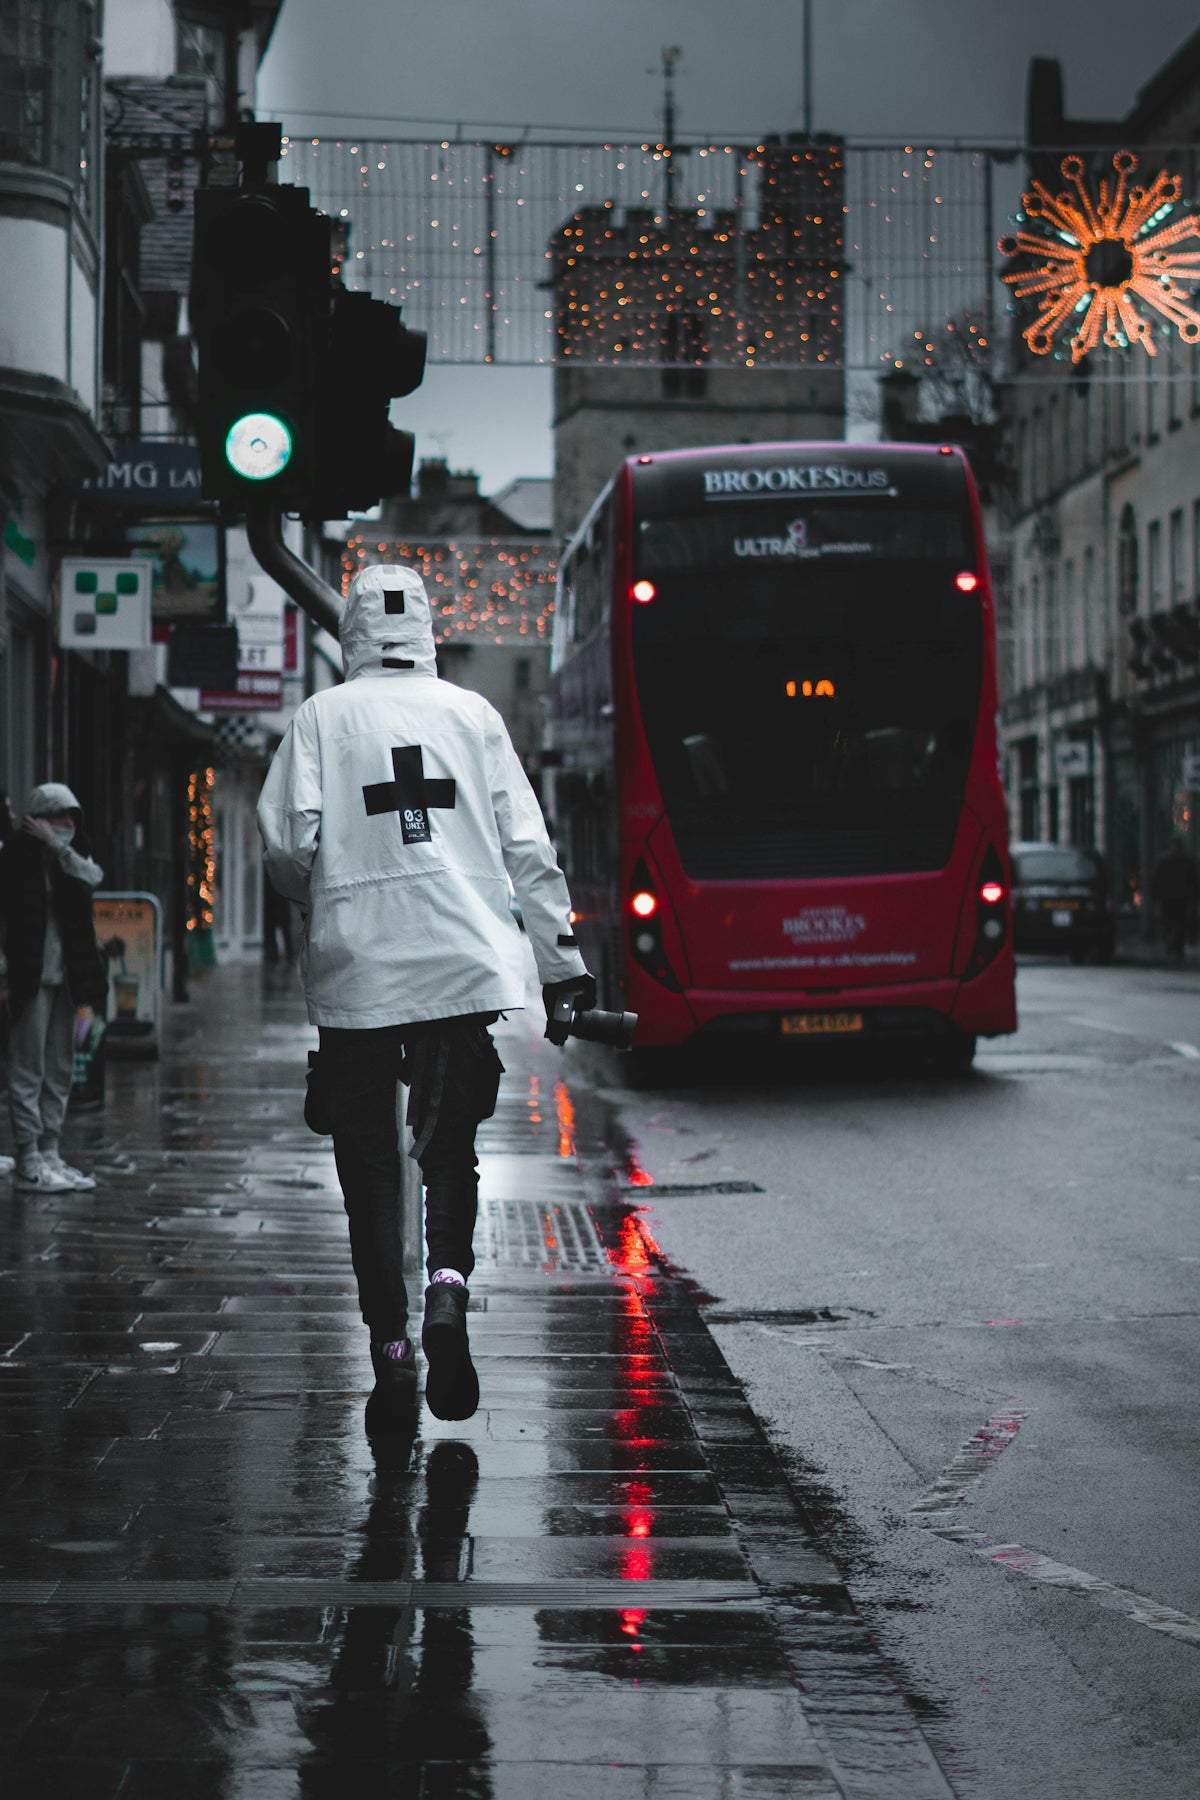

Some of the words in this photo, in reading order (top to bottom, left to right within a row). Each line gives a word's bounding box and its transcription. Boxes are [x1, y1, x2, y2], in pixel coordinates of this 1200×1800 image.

[703, 467, 888, 493] BROOKESbus
[734, 538, 797, 557] ULTRA
[404, 809, 424, 822] 03
[405, 822, 425, 830] UNIT
[784, 914, 866, 934] BROOKES
